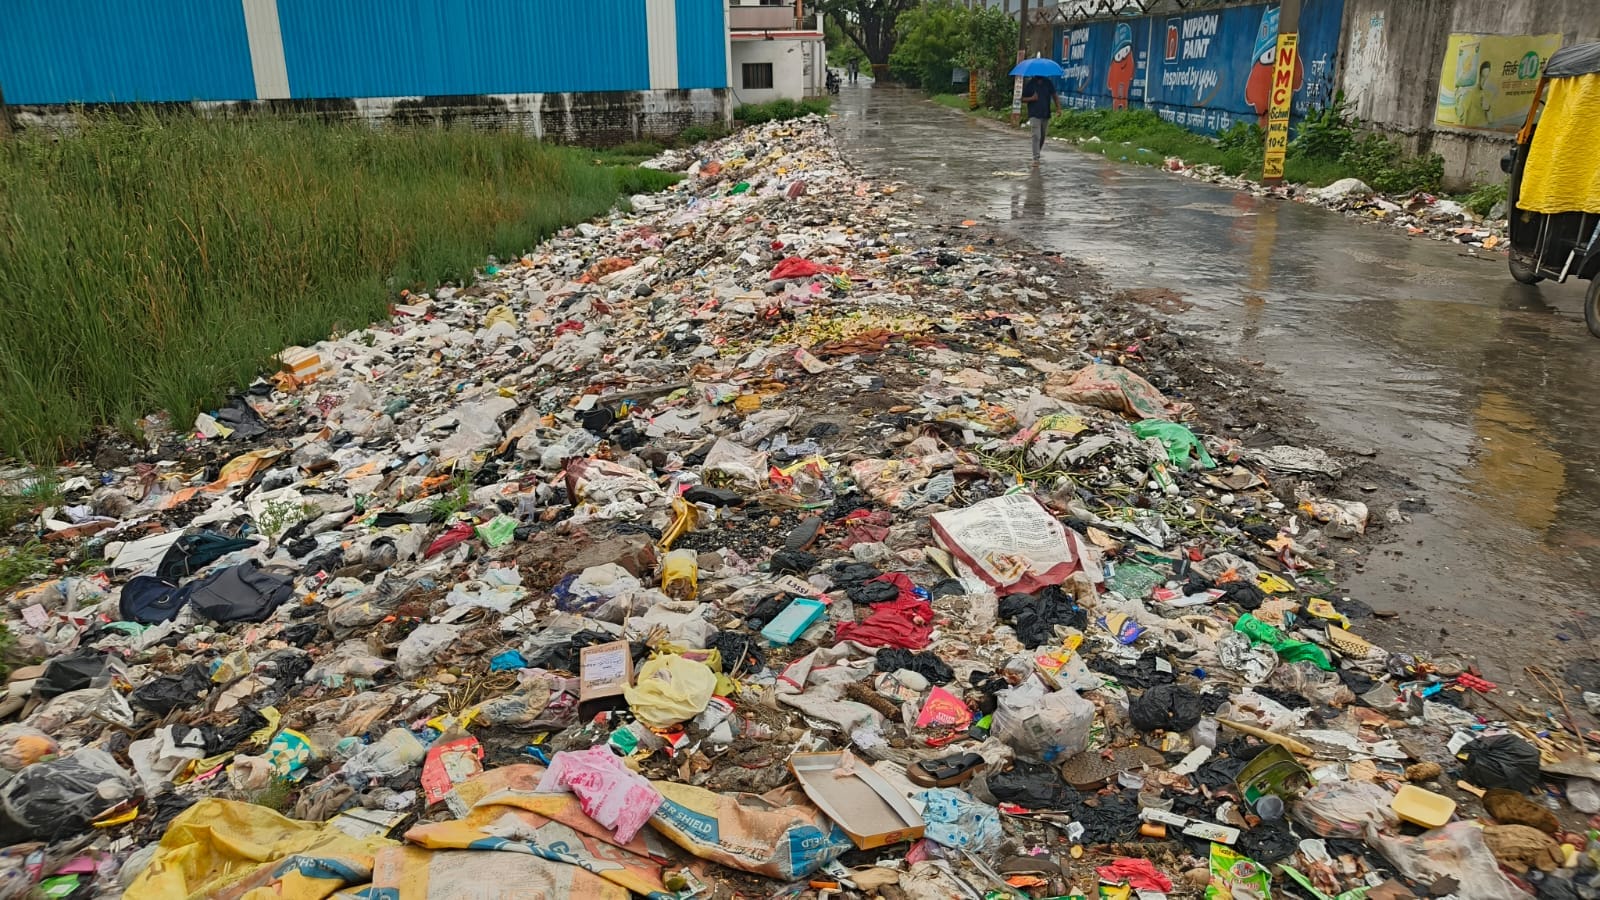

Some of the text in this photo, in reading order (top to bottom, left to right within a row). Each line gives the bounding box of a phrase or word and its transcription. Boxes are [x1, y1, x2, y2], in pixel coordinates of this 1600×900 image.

[1182, 14, 1219, 39] NIPPON
[1183, 38, 1210, 60] PAINT
[1521, 55, 1538, 77] 10
[1163, 66, 1190, 90] Inspired
[1190, 66, 1200, 89] by
[1197, 69, 1217, 100] you
[676, 812, 712, 834] SHIELD
